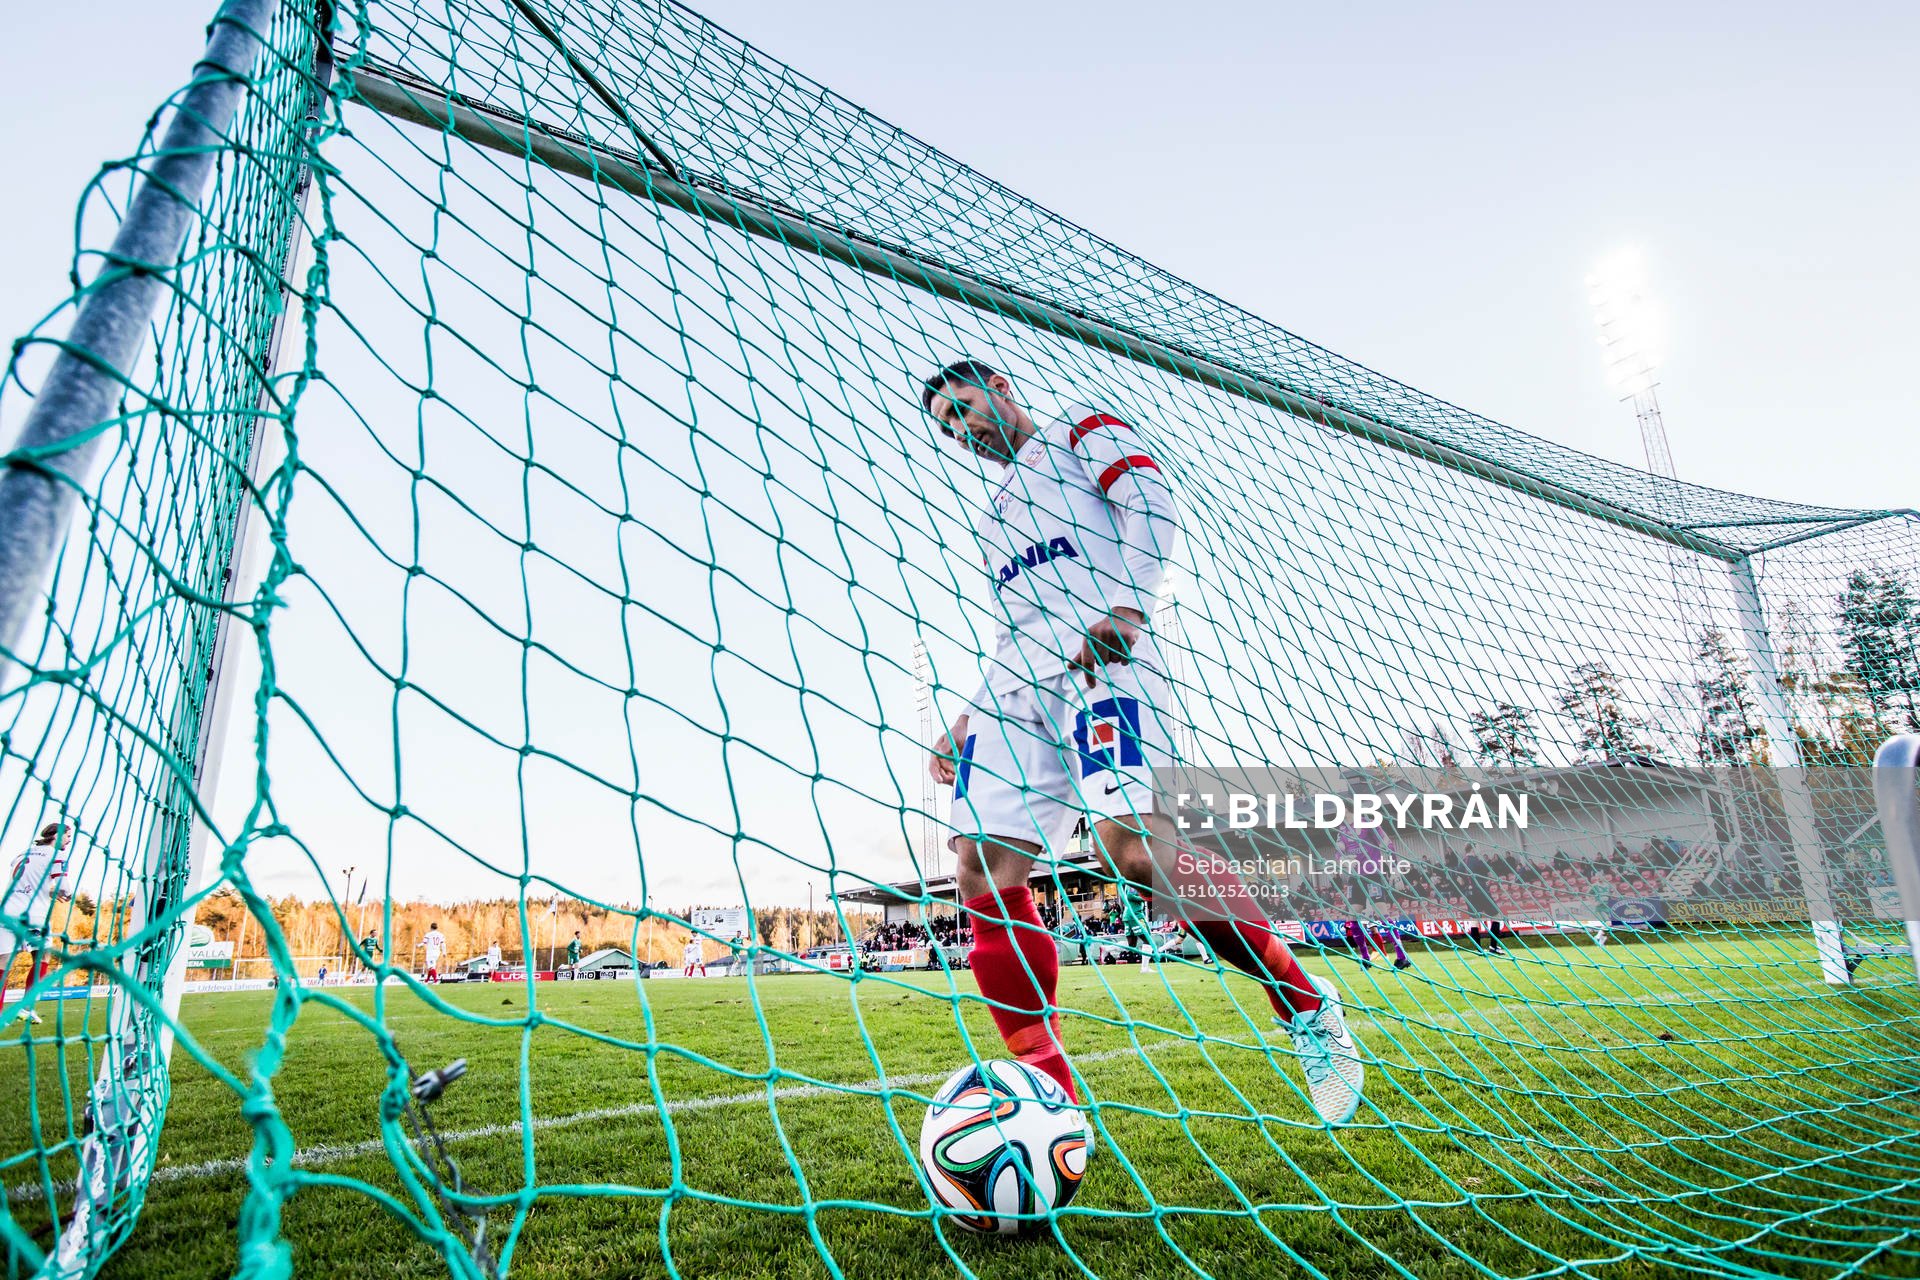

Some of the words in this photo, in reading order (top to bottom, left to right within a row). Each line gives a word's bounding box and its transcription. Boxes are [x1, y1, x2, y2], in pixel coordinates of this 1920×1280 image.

[1422, 921, 1439, 935] EL
[1442, 920, 1454, 934] &
[191, 950, 226, 958] VALLA
